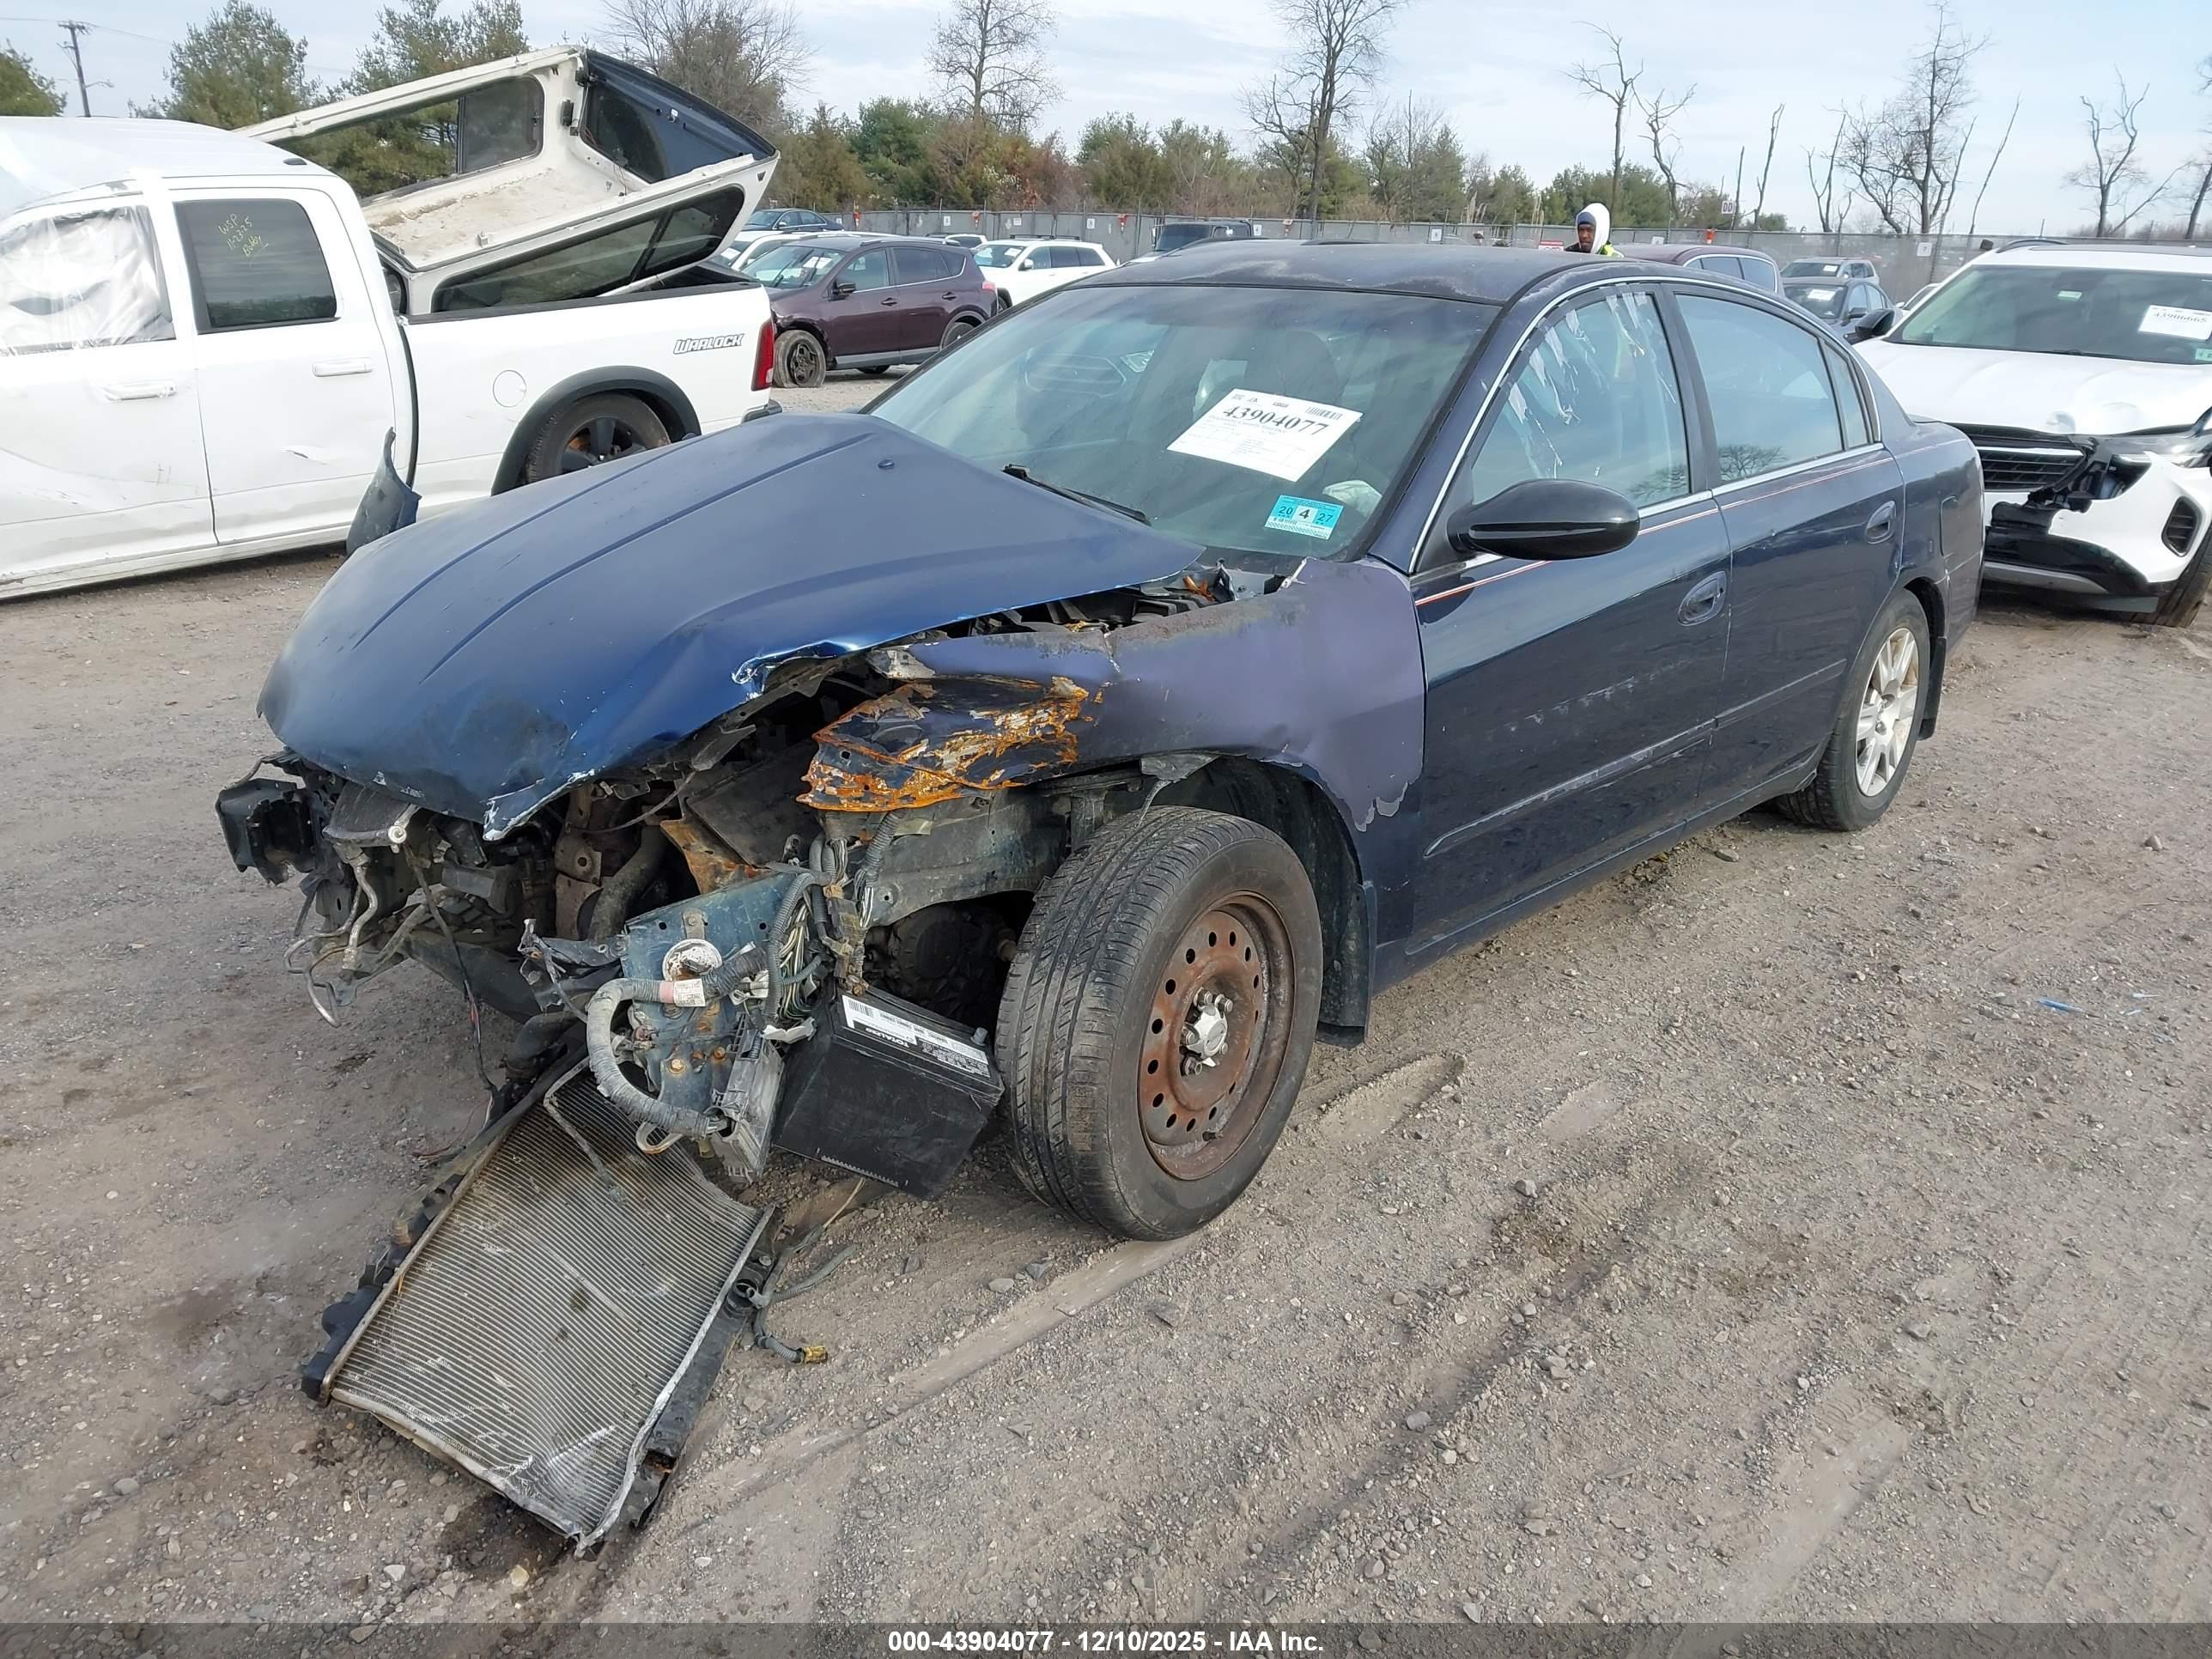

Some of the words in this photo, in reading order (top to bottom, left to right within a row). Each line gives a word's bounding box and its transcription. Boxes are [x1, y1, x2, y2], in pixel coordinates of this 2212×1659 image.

[673, 333, 744, 355] WARLOCK
[1223, 405, 1331, 436] 43904077
[1278, 506, 1294, 515] 20
[1298, 508, 1310, 520] 4
[1317, 513, 1334, 523] 27
